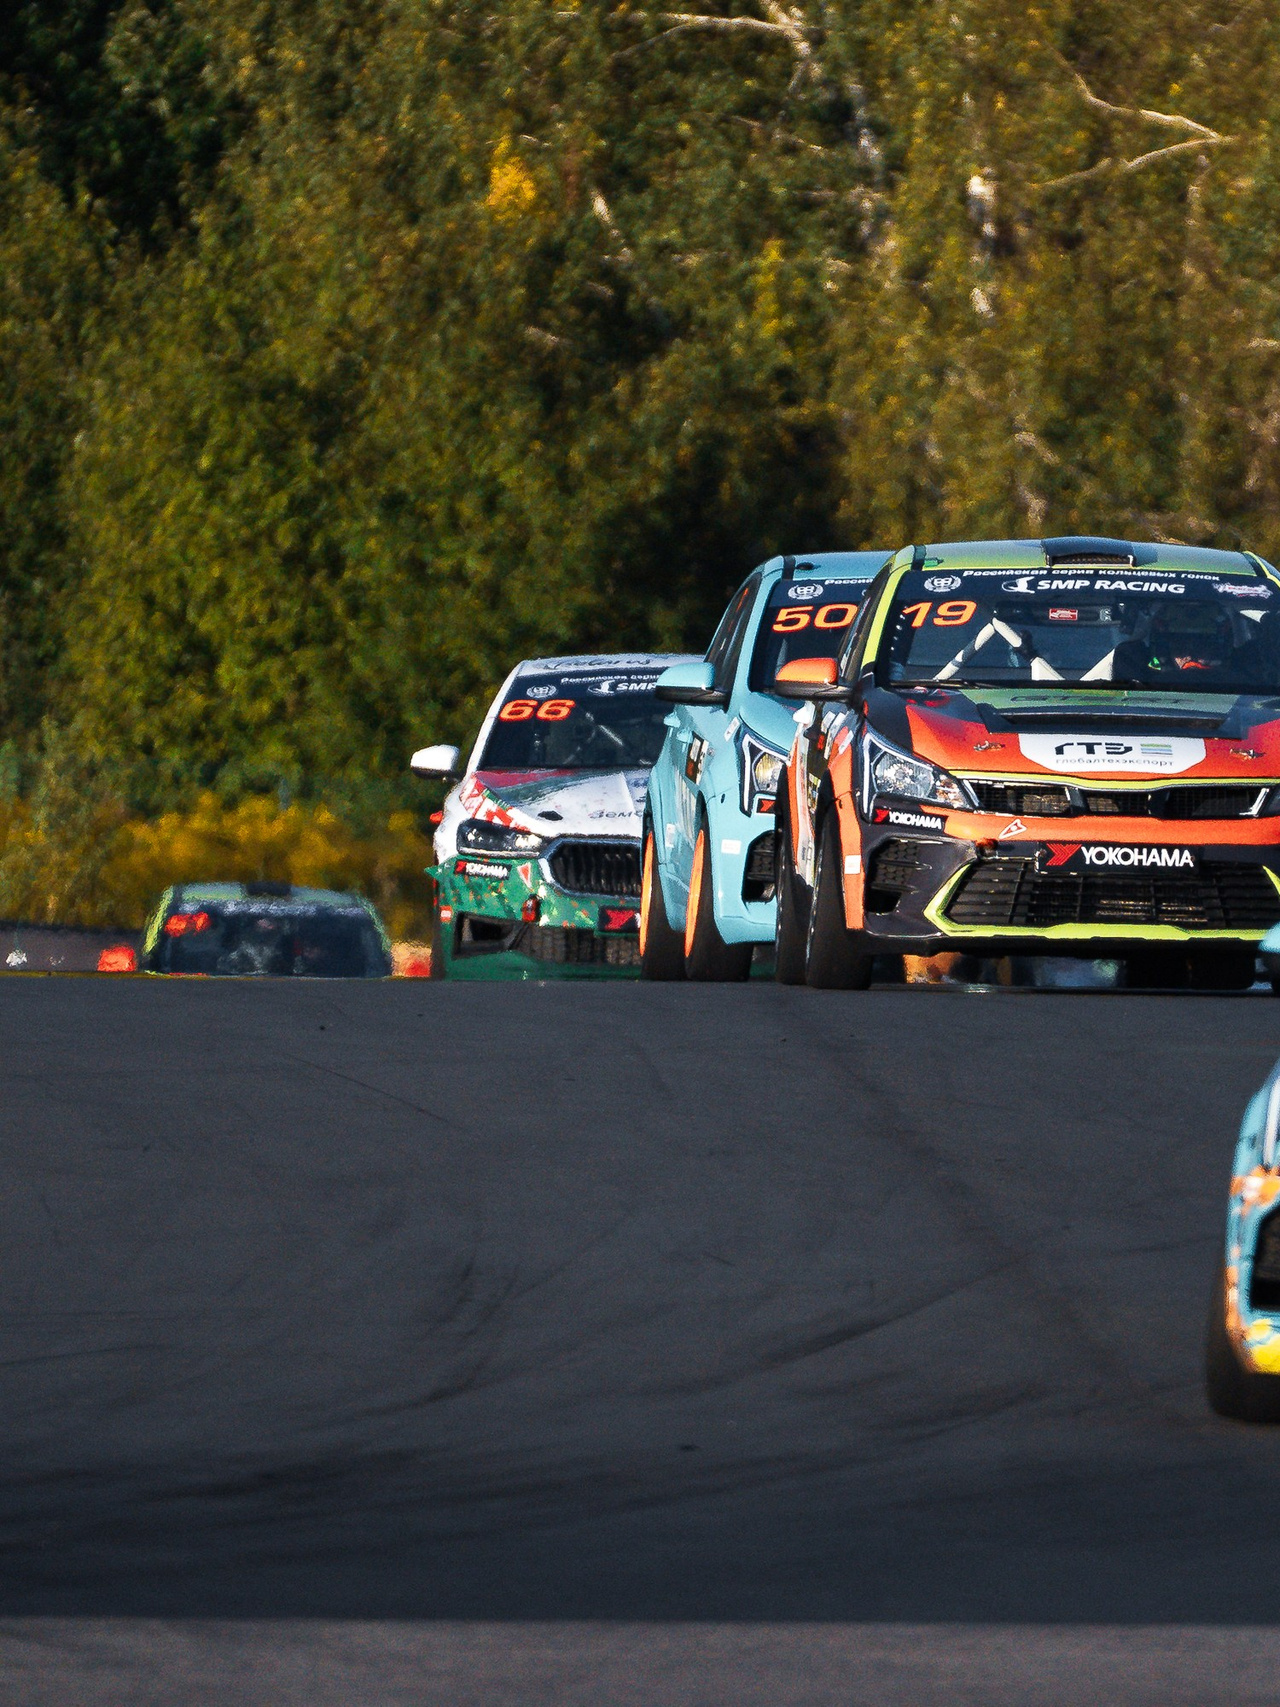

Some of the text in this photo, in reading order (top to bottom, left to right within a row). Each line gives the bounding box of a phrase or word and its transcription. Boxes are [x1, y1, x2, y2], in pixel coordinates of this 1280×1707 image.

[1037, 580, 1185, 594] SMP RACING
[772, 603, 859, 633] 50
[902, 600, 977, 628] 19
[499, 699, 576, 722] 66
[889, 811, 942, 830] YOKOHAMA
[1081, 846, 1195, 868] YOKOHAMA
